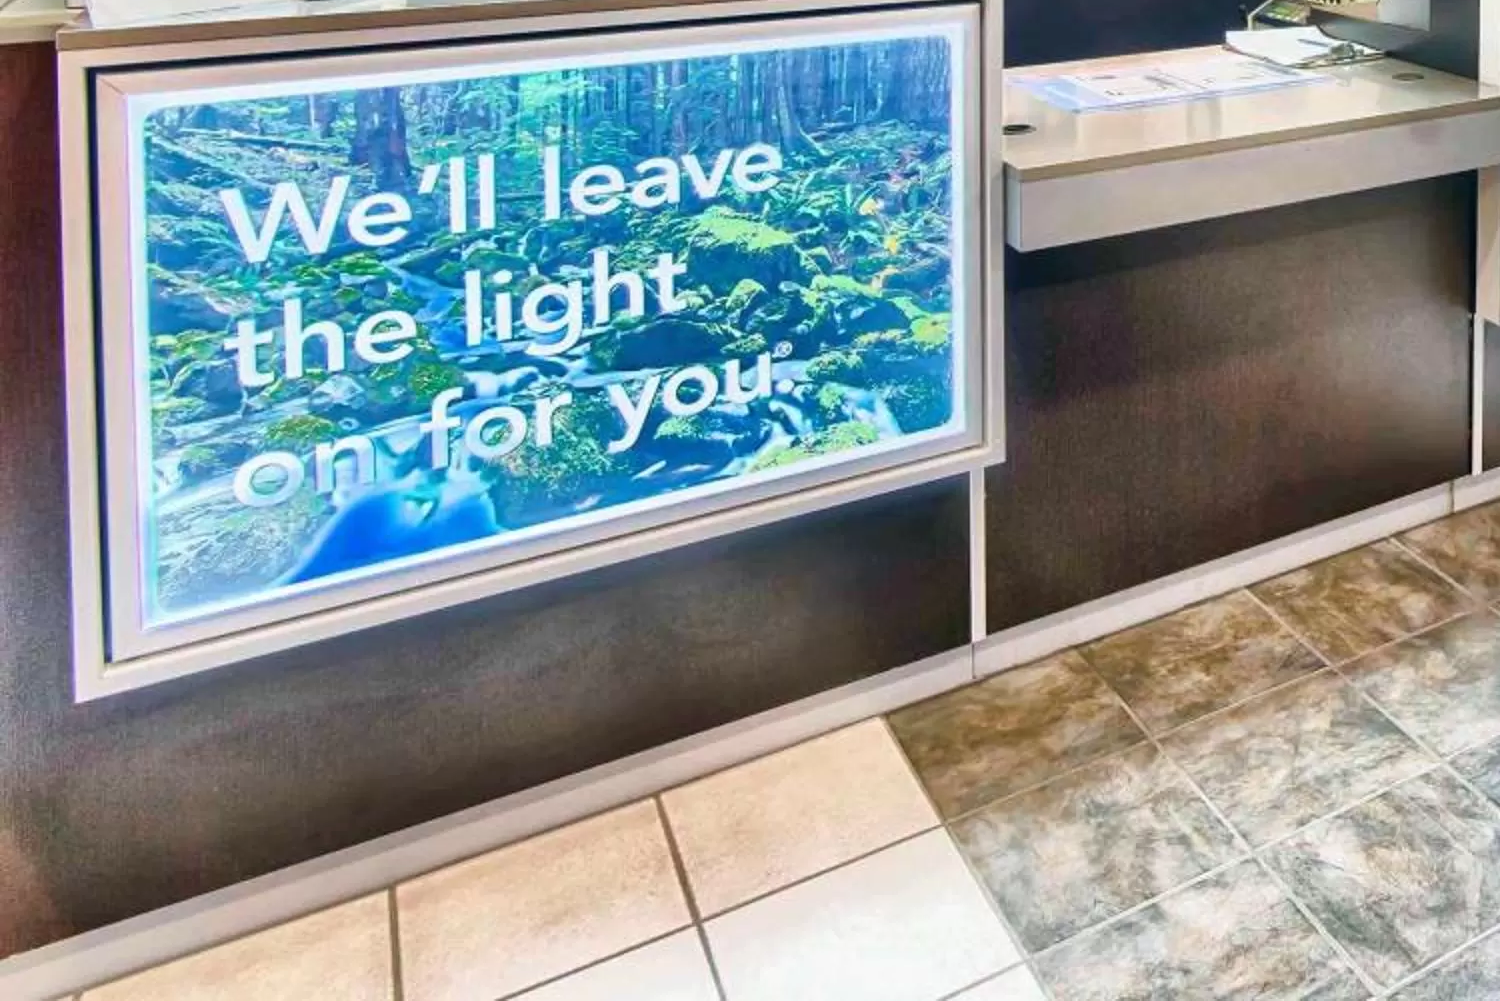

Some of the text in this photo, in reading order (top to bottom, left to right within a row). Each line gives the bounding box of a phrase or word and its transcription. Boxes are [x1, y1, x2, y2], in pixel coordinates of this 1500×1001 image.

[220, 142, 783, 264] We'll leave
[223, 248, 689, 389] the light
[233, 435, 375, 507] on
[419, 386, 573, 470] for
